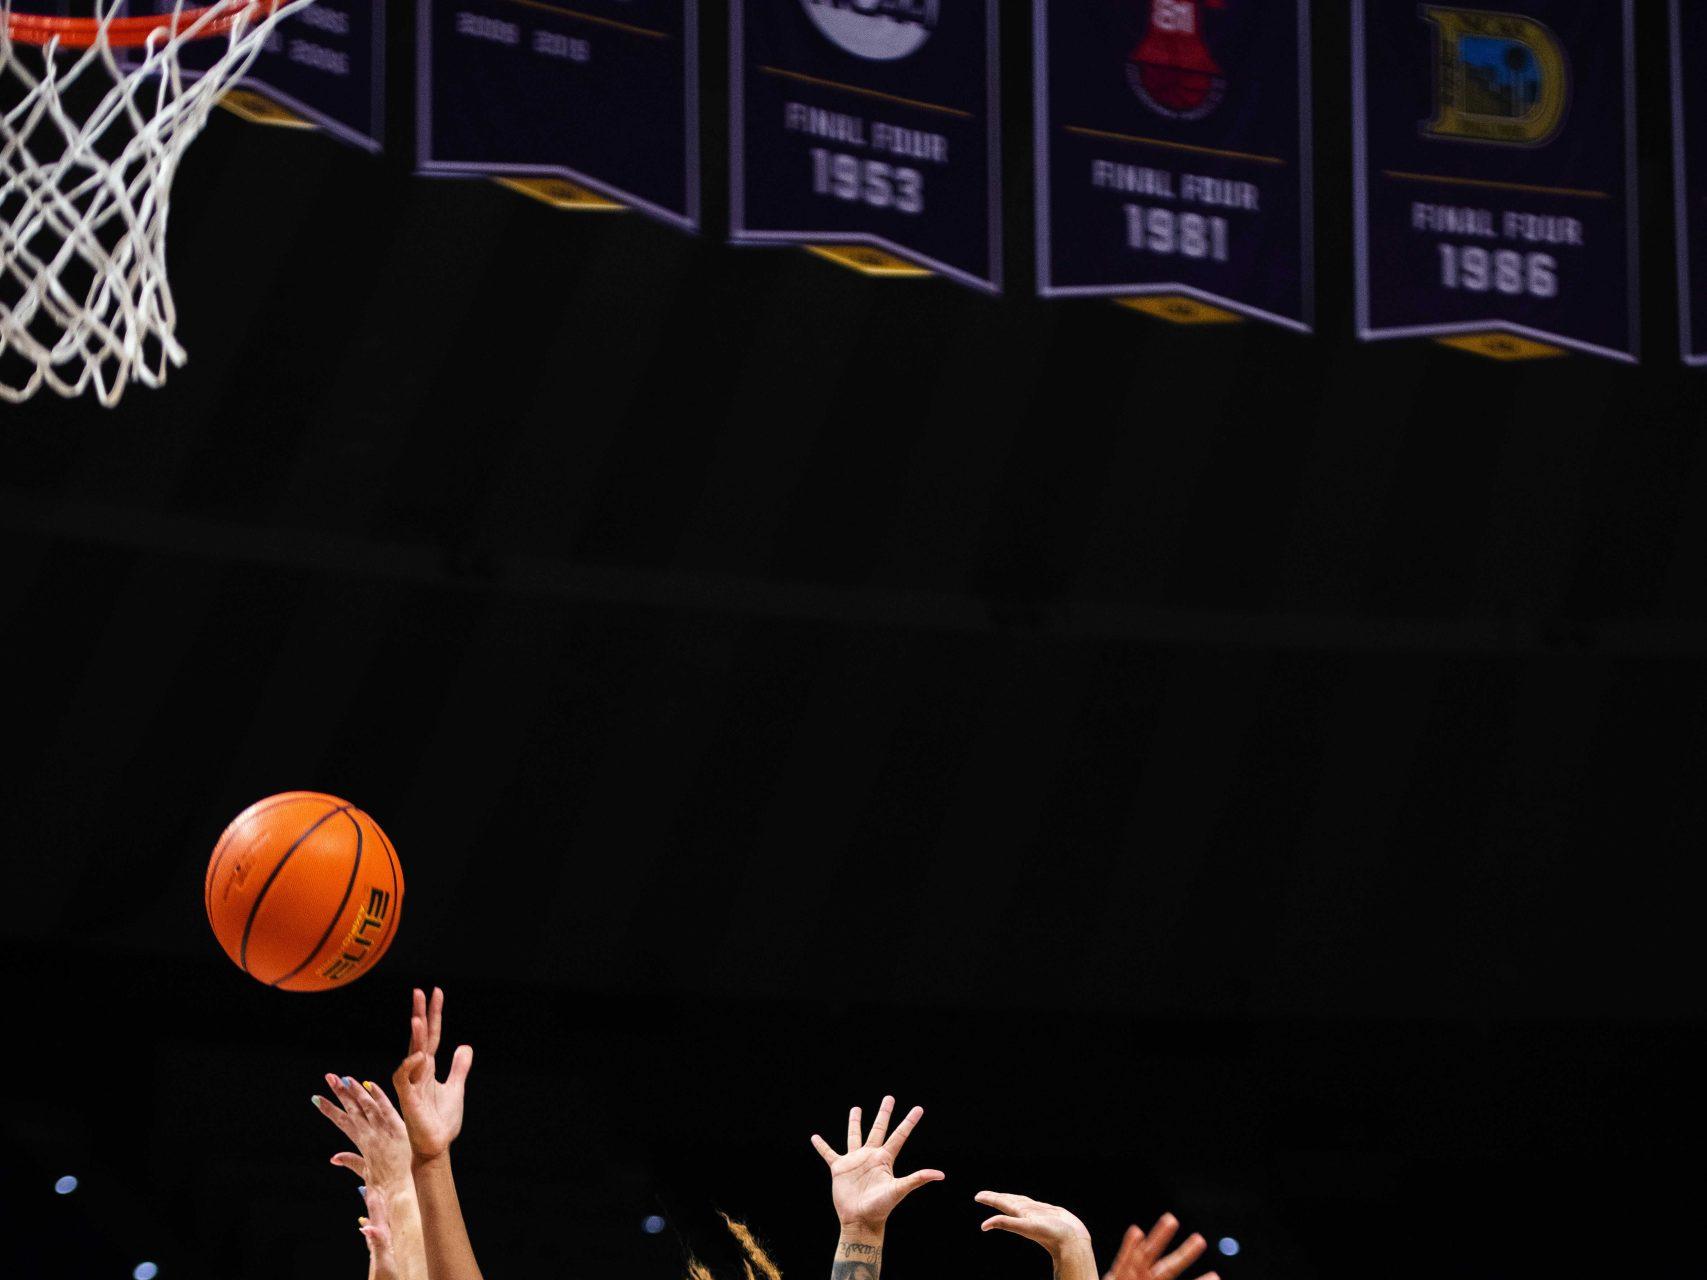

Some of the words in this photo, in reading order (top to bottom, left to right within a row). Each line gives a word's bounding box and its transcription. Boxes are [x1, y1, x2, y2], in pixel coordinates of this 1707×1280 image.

[784, 101, 868, 147] FINAL
[870, 120, 950, 164] FOUR
[809, 146, 925, 216] 1953
[1090, 158, 1177, 200] FINAL
[1178, 172, 1260, 213] FOUR
[1121, 201, 1231, 264] 1981
[1410, 200, 1499, 239] FINAL
[1501, 209, 1584, 248] FOUR
[1437, 242, 1559, 300] 1986
